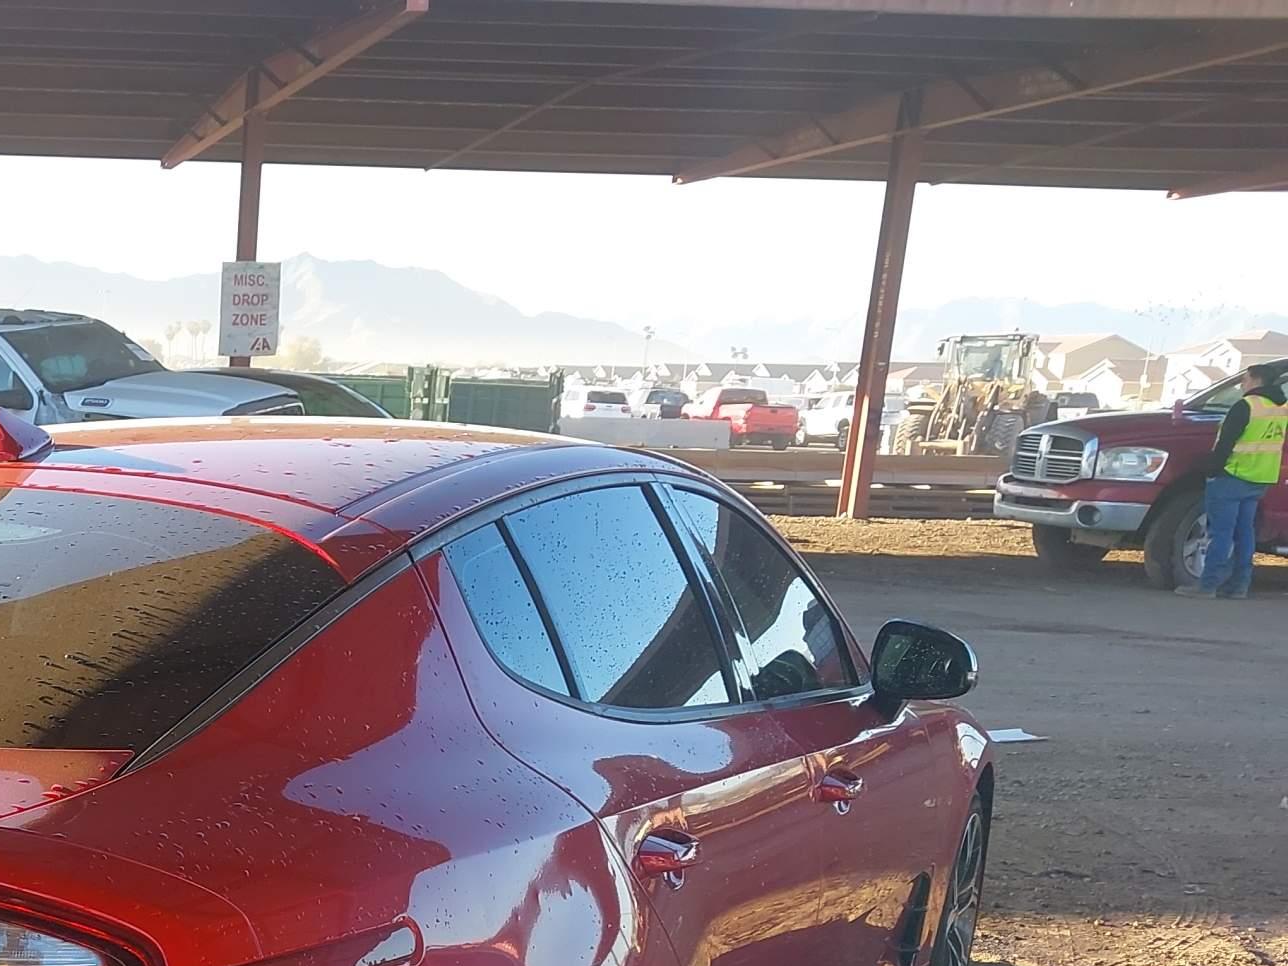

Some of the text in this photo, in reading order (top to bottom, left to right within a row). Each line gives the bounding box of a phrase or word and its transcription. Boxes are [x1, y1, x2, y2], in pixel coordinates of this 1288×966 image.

[233, 274, 269, 287] MISC.
[232, 293, 269, 306] DROP
[232, 313, 267, 327] ZONE
